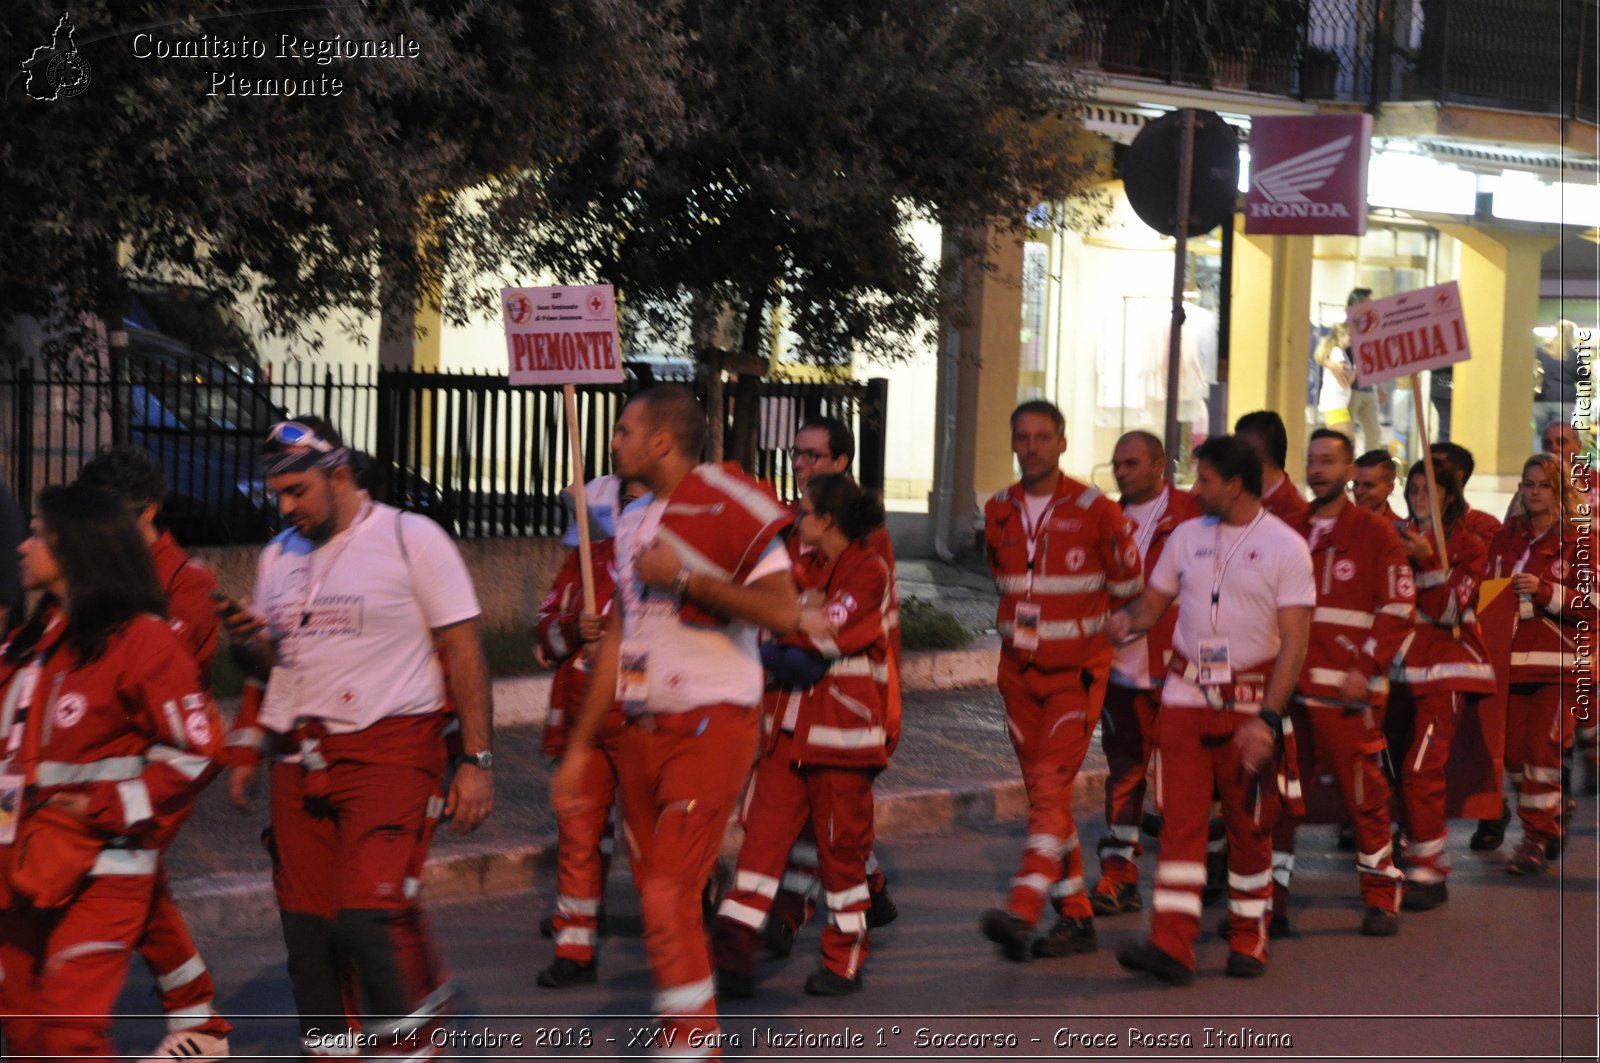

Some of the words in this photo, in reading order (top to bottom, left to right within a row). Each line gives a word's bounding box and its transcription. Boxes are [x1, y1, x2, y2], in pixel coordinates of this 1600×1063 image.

[1250, 202, 1350, 218] HONDA
[511, 331, 617, 372] PIEMONTE
[1359, 323, 1448, 376] SICILIA
